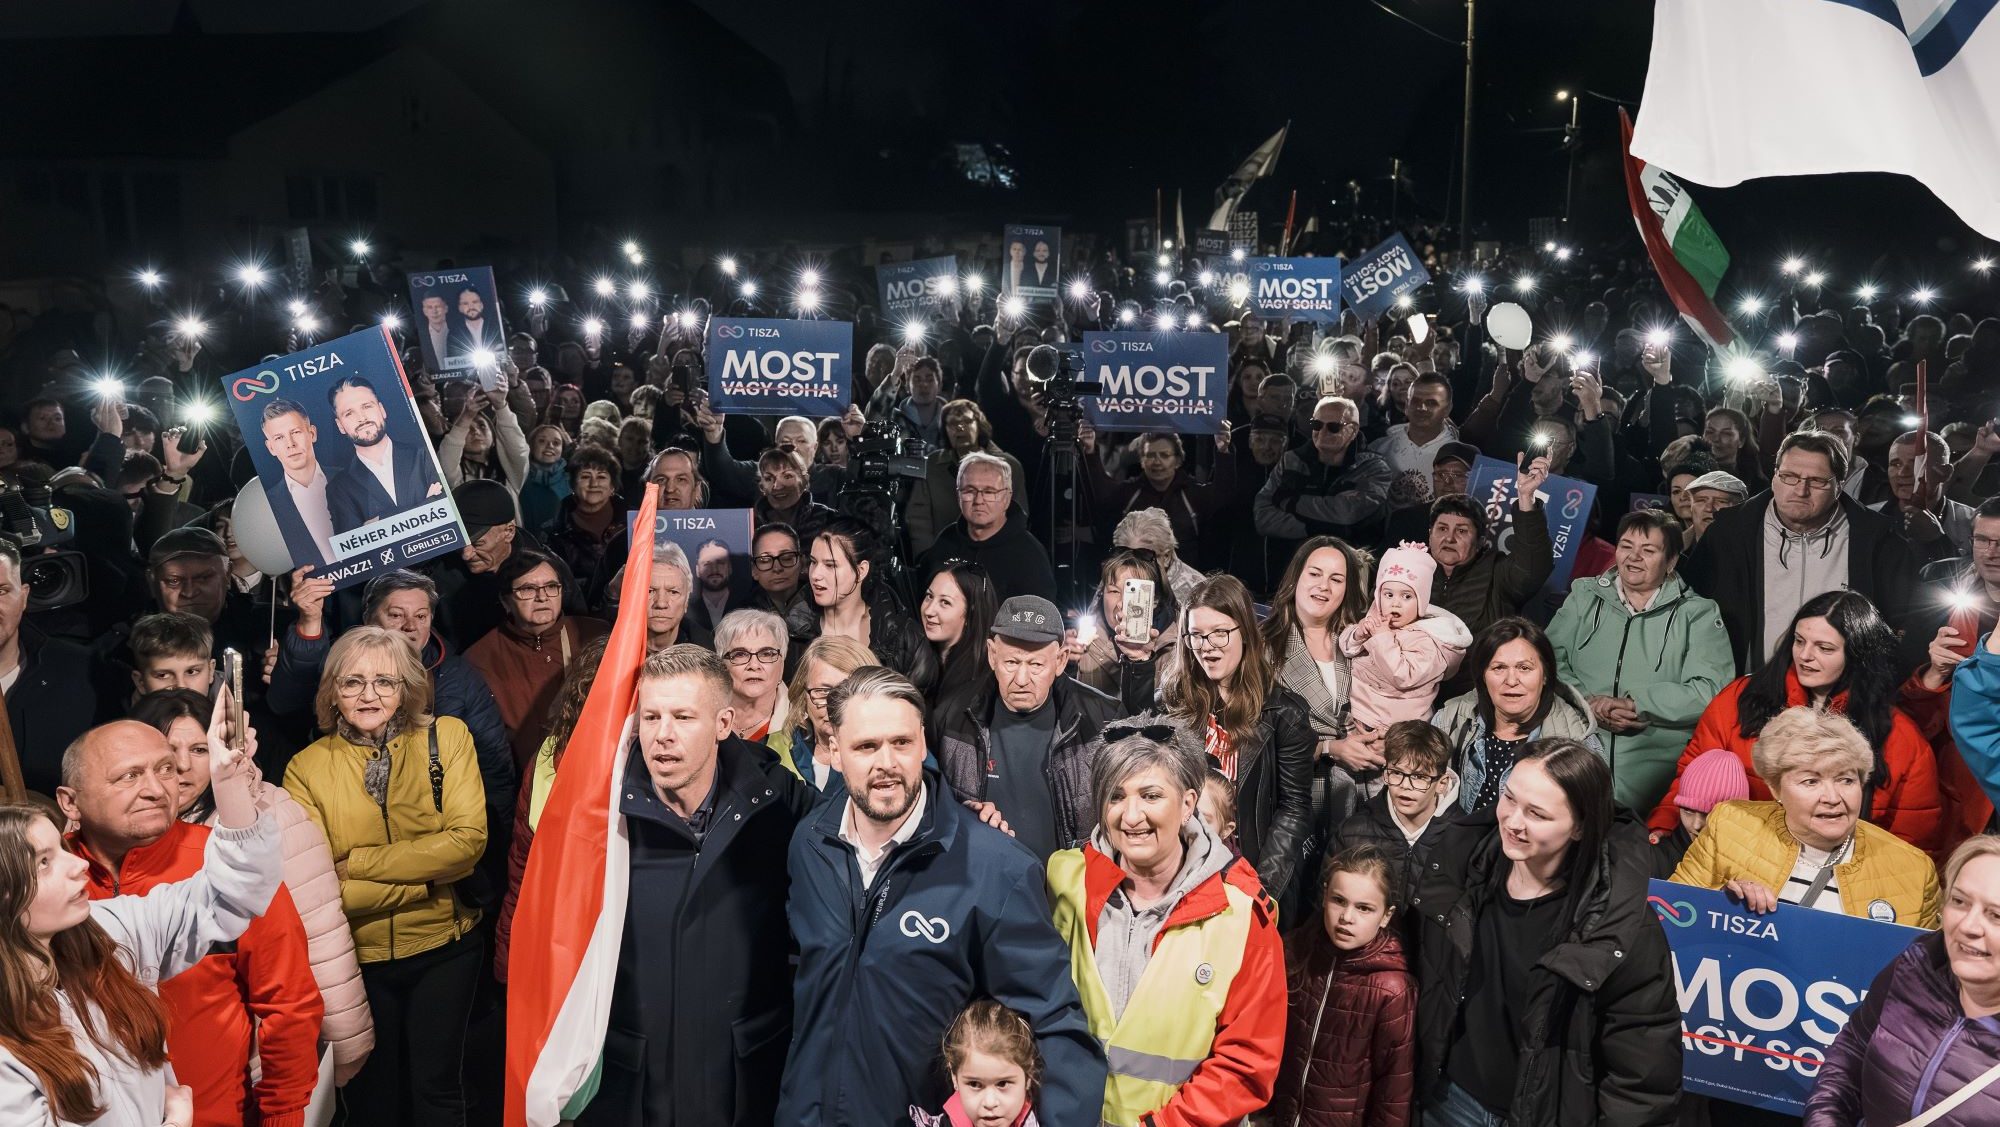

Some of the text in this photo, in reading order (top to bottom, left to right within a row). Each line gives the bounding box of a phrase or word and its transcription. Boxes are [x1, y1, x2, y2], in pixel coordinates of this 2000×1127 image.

[1273, 263, 1294, 271] TISZA
[1352, 252, 1412, 304] MOST
[437, 273, 469, 285] TISZA
[887, 275, 950, 300] MOS
[1258, 277, 1333, 299] MOST
[1257, 298, 1332, 310] VAGY SOHA!
[748, 327, 781, 338] TISZA
[1121, 342, 1154, 352] TISZA
[284, 352, 345, 382] TISZA
[721, 349, 840, 382] MOST
[720, 380, 839, 399] VAGY SOHA!
[1098, 364, 1216, 397] MOST
[1096, 397, 1213, 415] VAGY SOHA!
[339, 507, 448, 553] NÉHER ANDRÁS
[673, 517, 717, 530] TISZA
[407, 537, 440, 554] ÁPRILIS
[440, 533, 453, 543] 12.
[1552, 524, 1572, 559] TISZA
[1707, 910, 1779, 941] TISZA
[1671, 950, 1868, 1046] MOS
